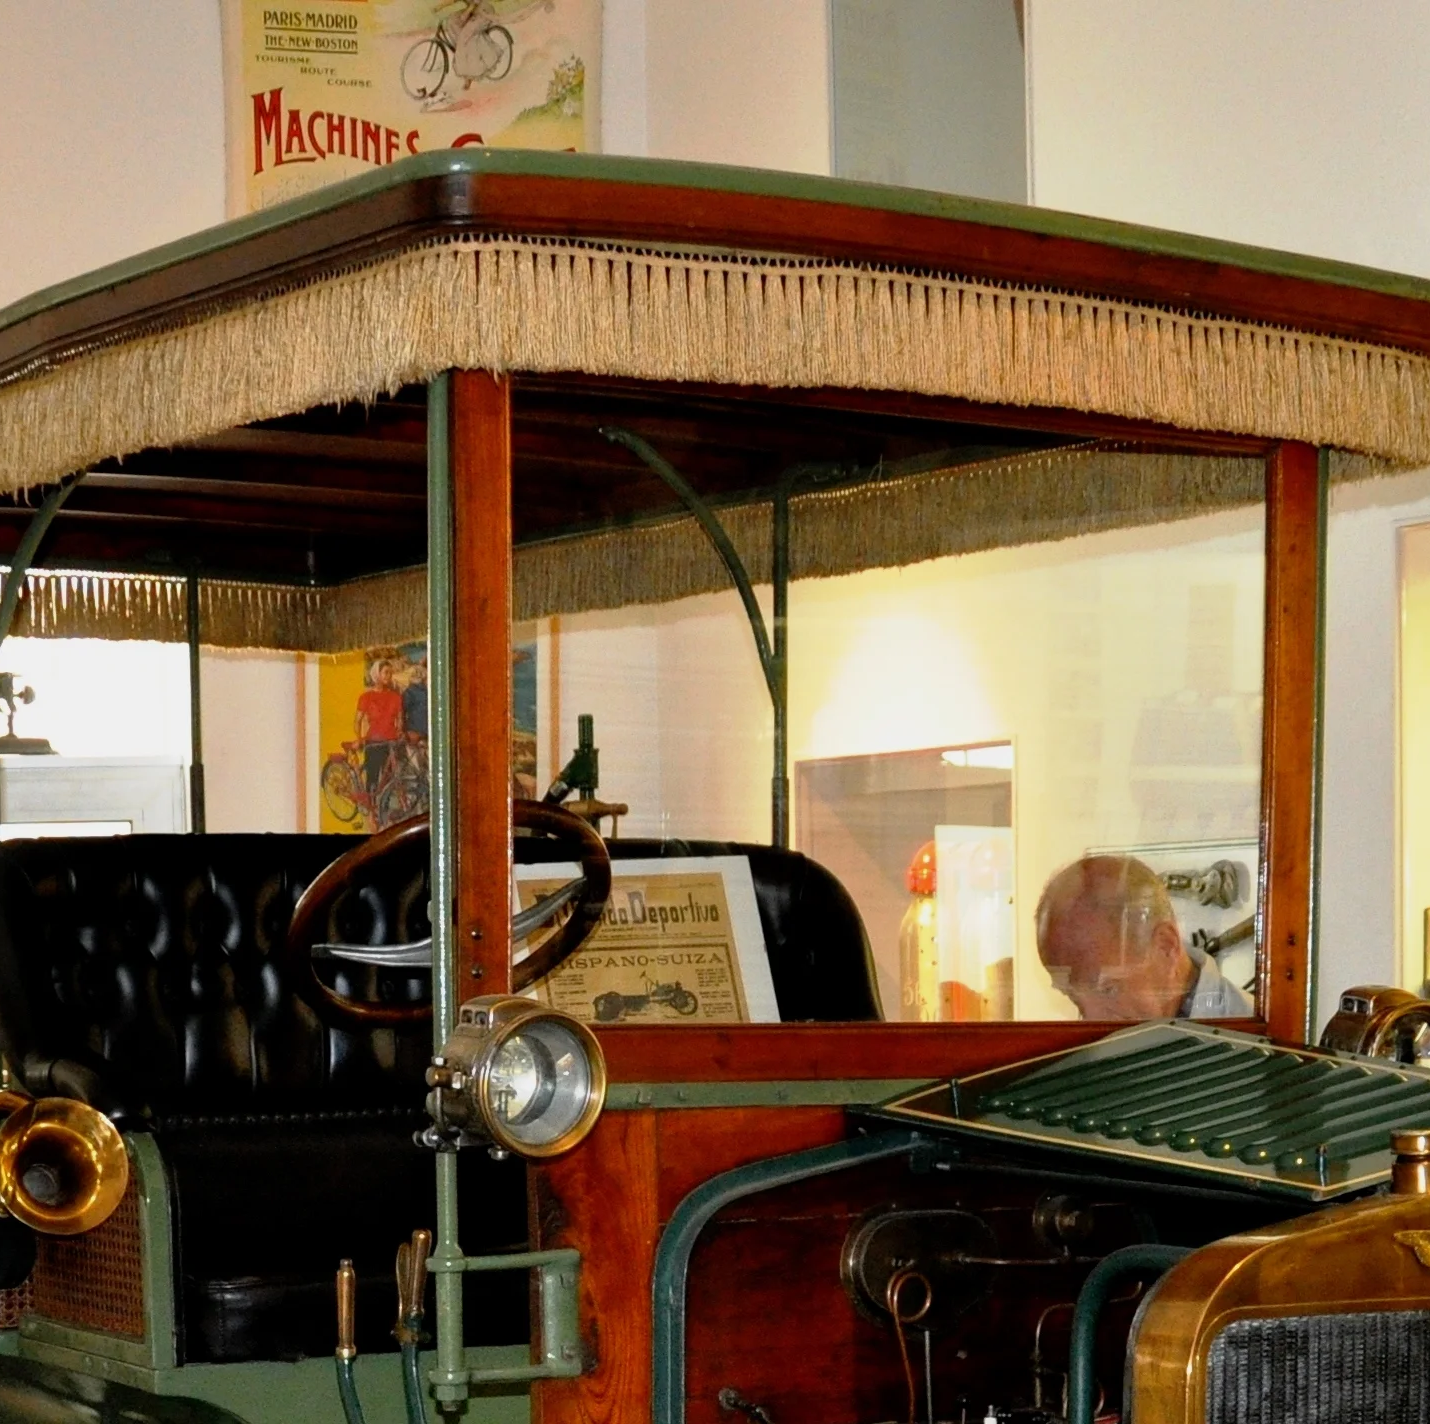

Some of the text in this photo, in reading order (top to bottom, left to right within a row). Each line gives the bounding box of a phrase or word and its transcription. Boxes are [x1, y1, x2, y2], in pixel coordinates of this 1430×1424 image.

[263, 11, 358, 30] PARIS MADRID
[265, 34, 358, 50] THE NEW BOSTON
[255, 54, 311, 64] TOURISME
[299, 67, 336, 75] ROUTE
[326, 78, 373, 87] COURSE
[251, 87, 421, 175] MACHINES
[627, 891, 720, 933] Deportivo
